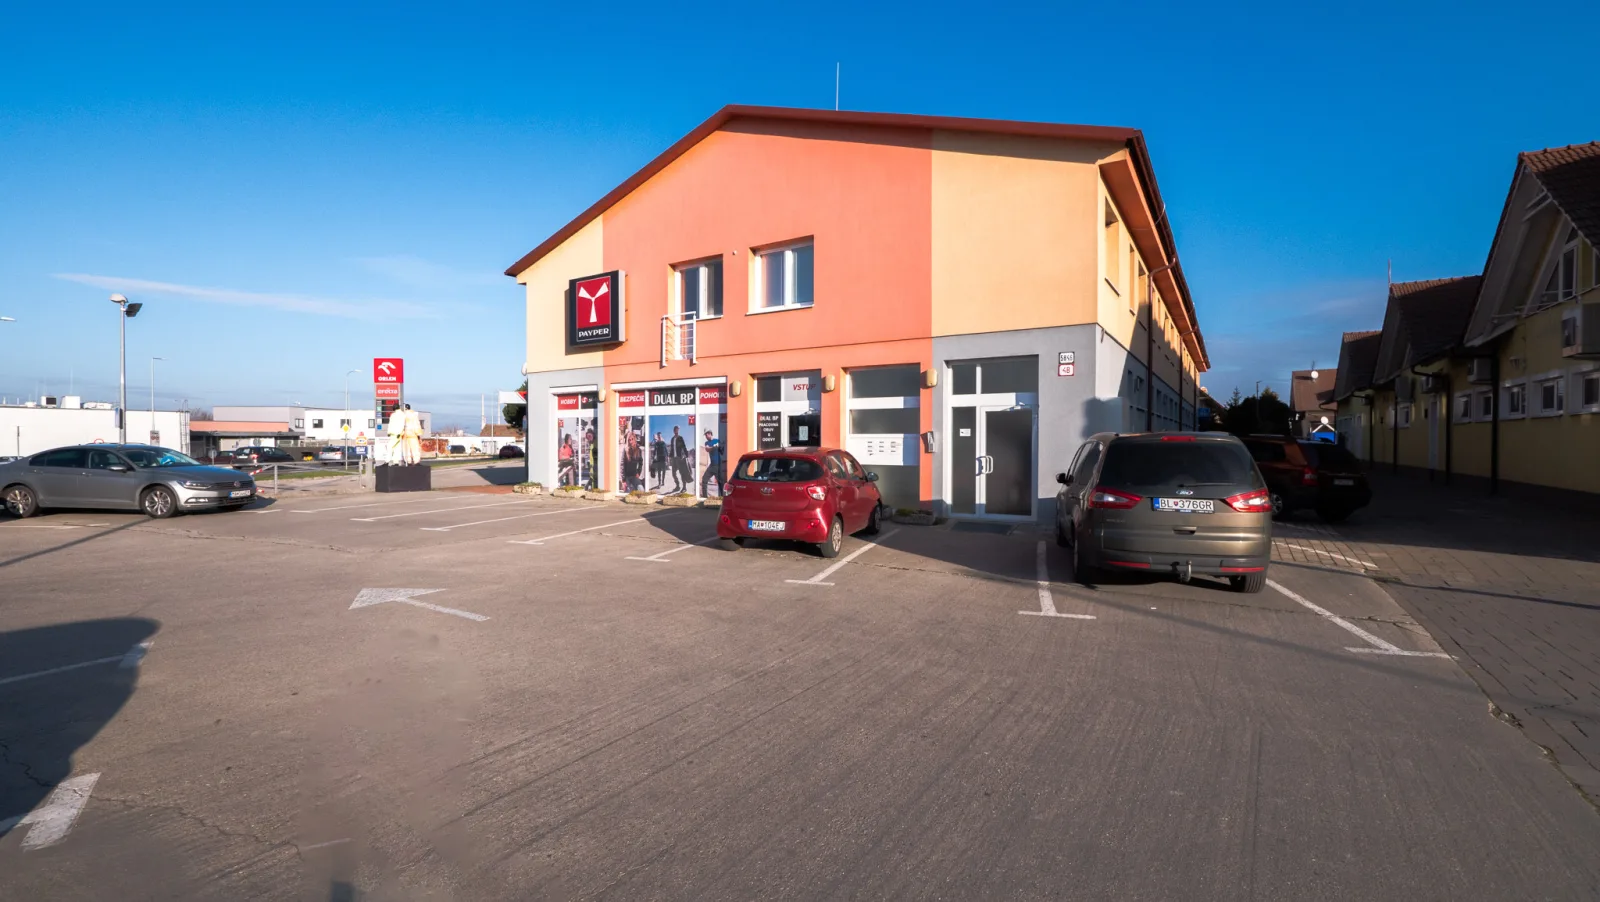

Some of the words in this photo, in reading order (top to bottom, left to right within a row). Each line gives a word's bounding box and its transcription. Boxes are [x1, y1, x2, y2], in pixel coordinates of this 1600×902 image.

[578, 328, 609, 337] PAYPER
[653, 394, 678, 405] DUAL
[680, 393, 694, 404] BP
